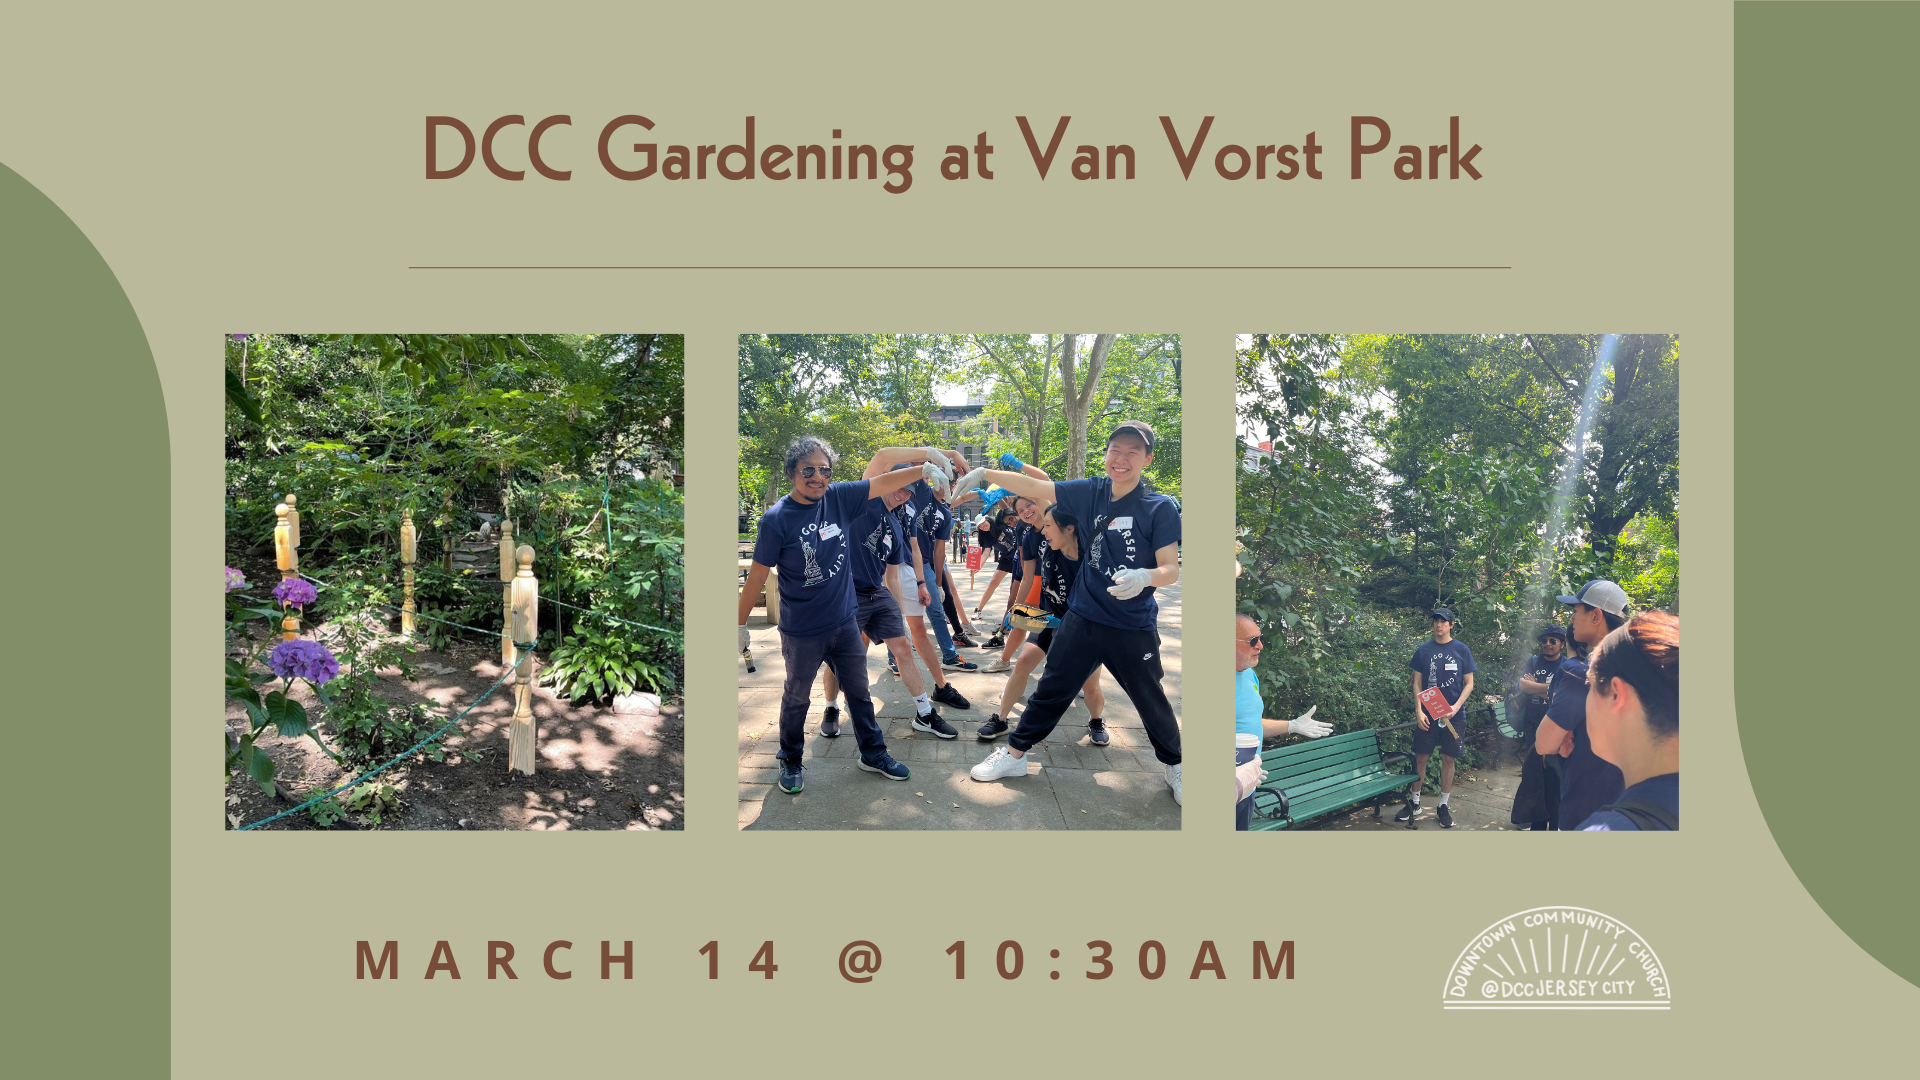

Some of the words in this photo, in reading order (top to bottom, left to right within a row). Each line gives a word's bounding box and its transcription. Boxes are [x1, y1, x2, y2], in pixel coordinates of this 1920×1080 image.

[801, 523, 817, 536] GO
[828, 553, 845, 578] CITY
[1433, 652, 1443, 660] GO
[1440, 677, 1455, 688] CITY
[1421, 689, 1436, 702] go
